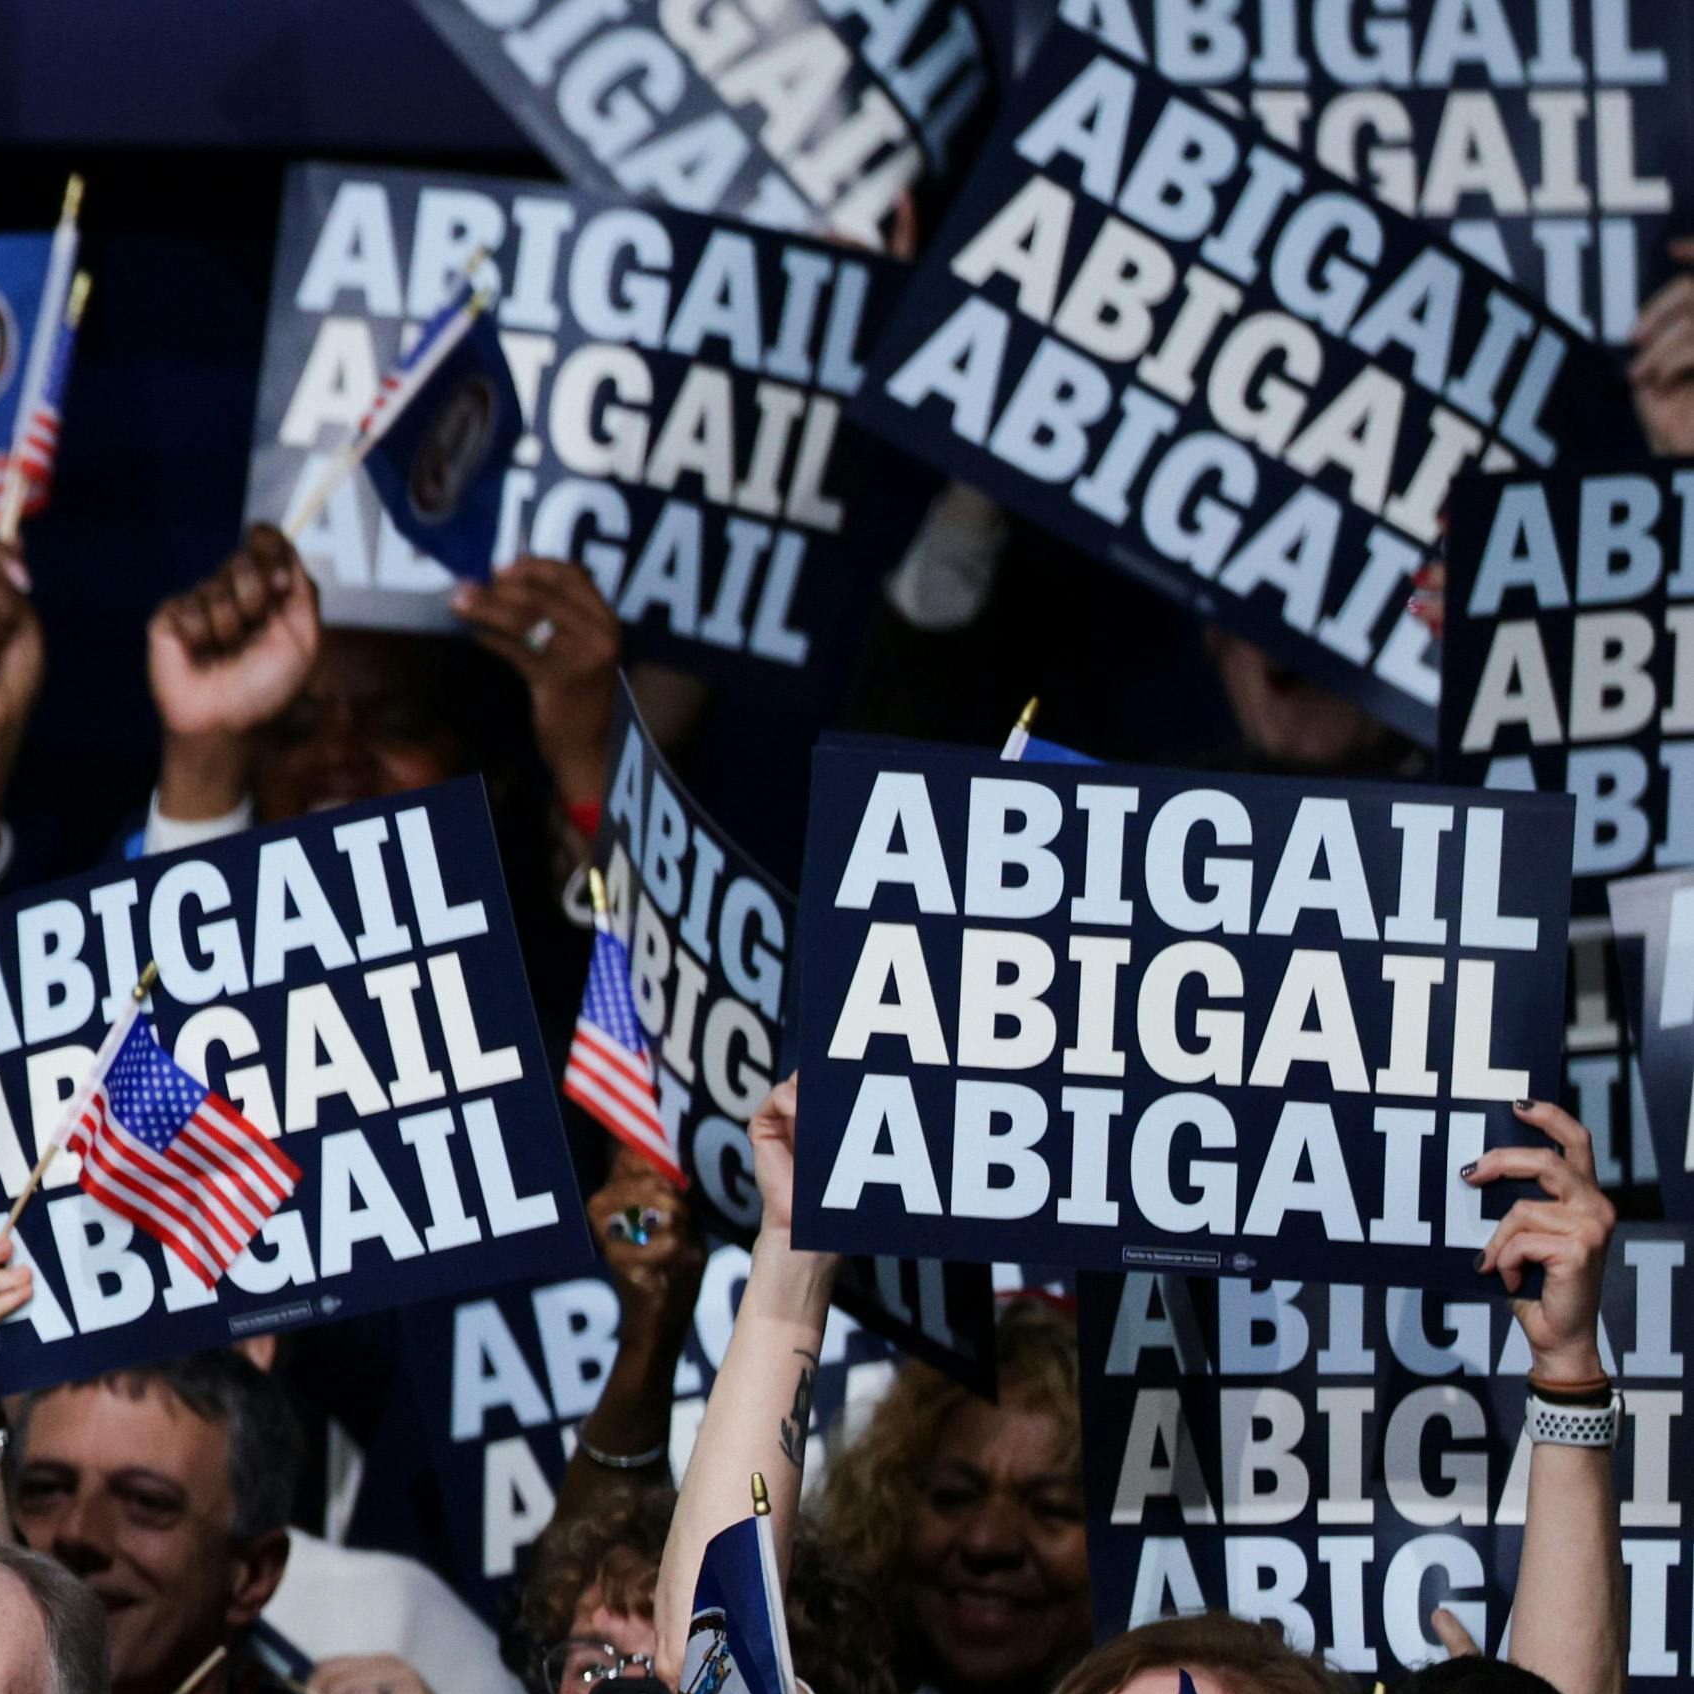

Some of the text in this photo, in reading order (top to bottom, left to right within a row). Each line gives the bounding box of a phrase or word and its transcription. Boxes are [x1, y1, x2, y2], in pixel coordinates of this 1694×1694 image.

[296, 181, 871, 395] ABIGAIL
[1015, 53, 1568, 468] ABIGAIL
[278, 316, 845, 533] AGAIL
[950, 174, 1518, 546] ABIGAI
[611, 720, 785, 1025] ABIG
[833, 770, 1540, 952] ABIGAIL
[827, 922, 1530, 1101] ABIGAIL
[820, 1072, 1503, 1251] ABIGAIL
[1110, 1384, 1694, 1528] ABIGI
[1126, 1534, 1694, 1678] ABIGI
